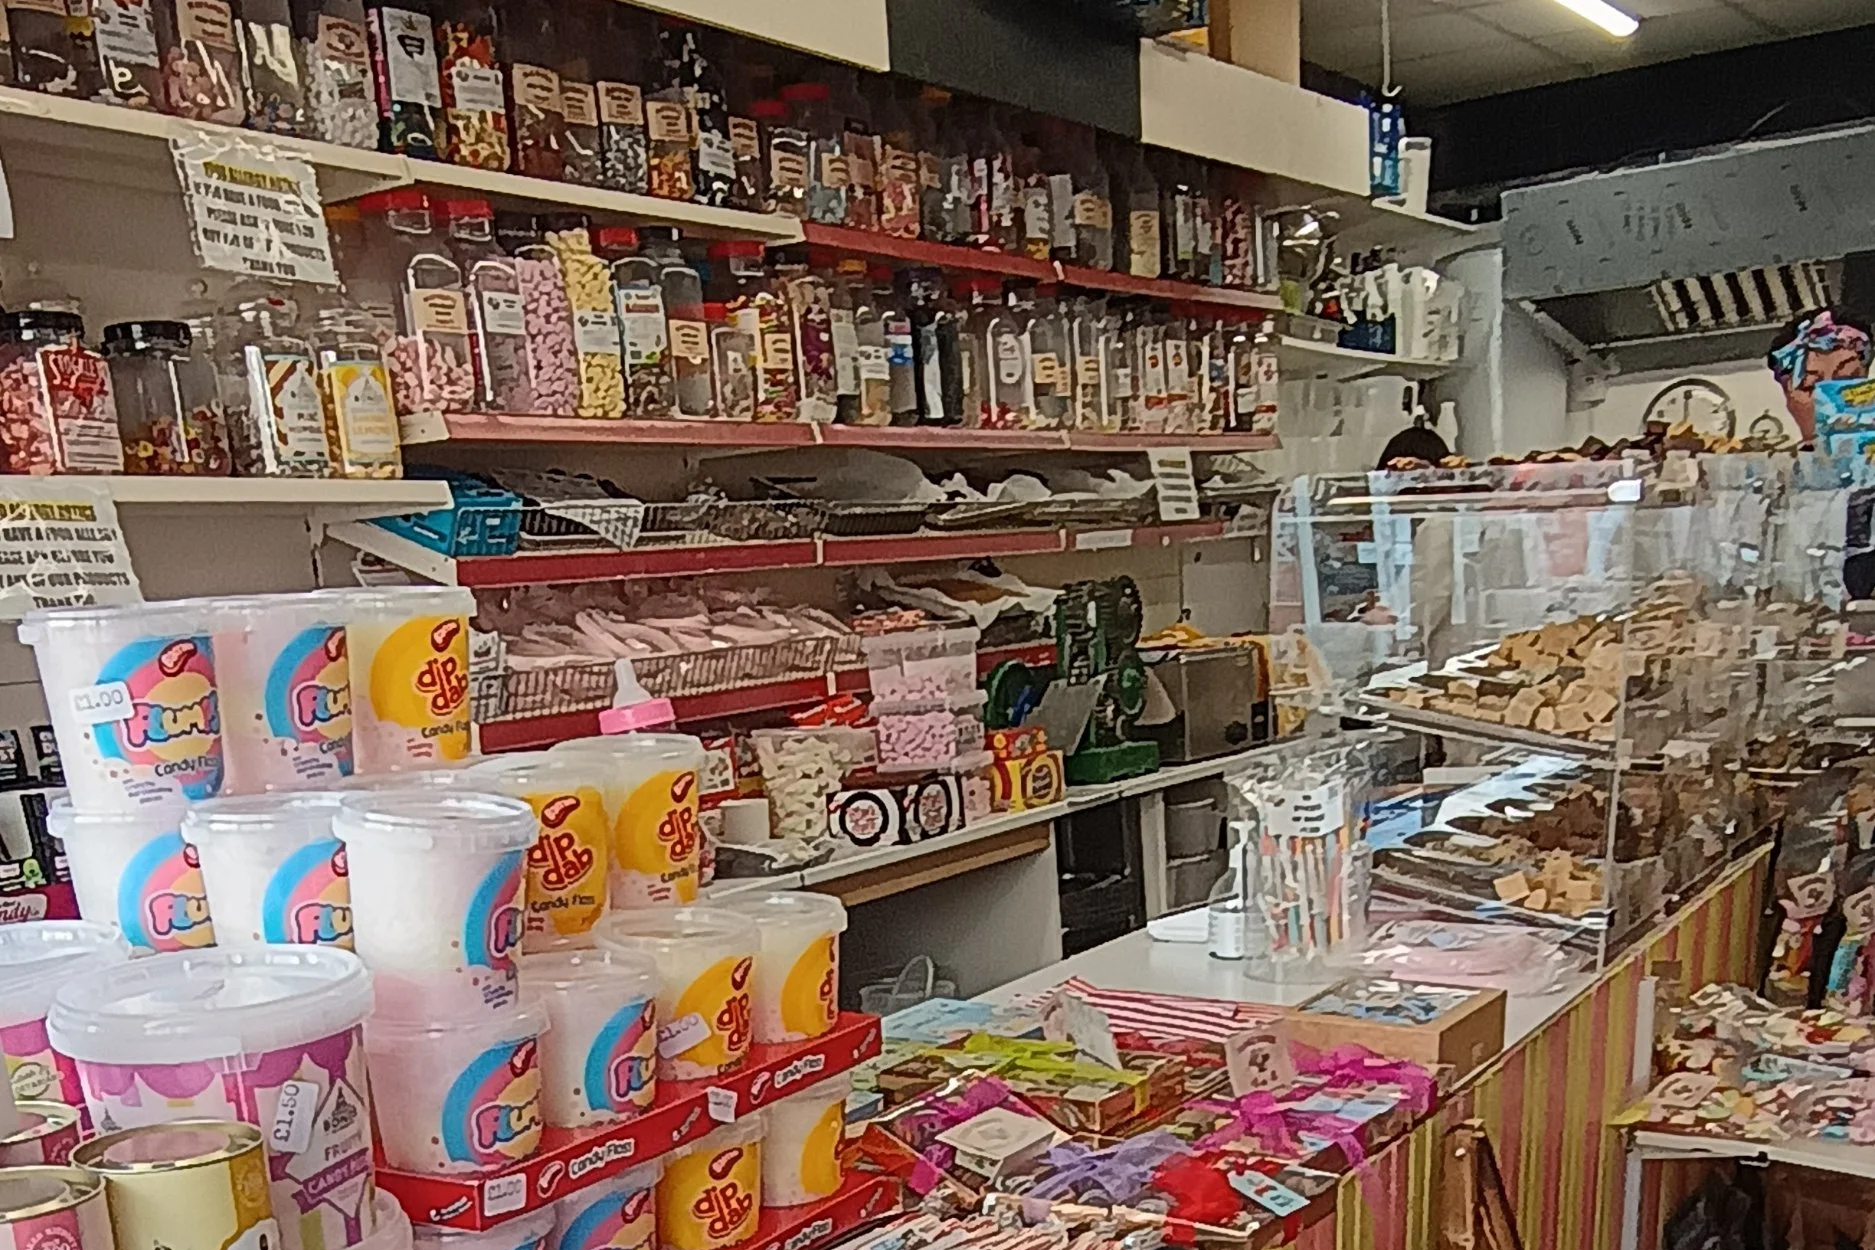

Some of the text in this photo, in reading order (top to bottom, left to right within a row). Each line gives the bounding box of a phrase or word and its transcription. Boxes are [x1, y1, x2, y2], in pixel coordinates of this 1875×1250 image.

[154, 758, 196, 778] Candy
[541, 848, 594, 891] dab
[531, 897, 569, 914] Candy
[273, 1083, 300, 1142] £1.50
[571, 1152, 606, 1176] Candy
[708, 1193, 753, 1238] dab
